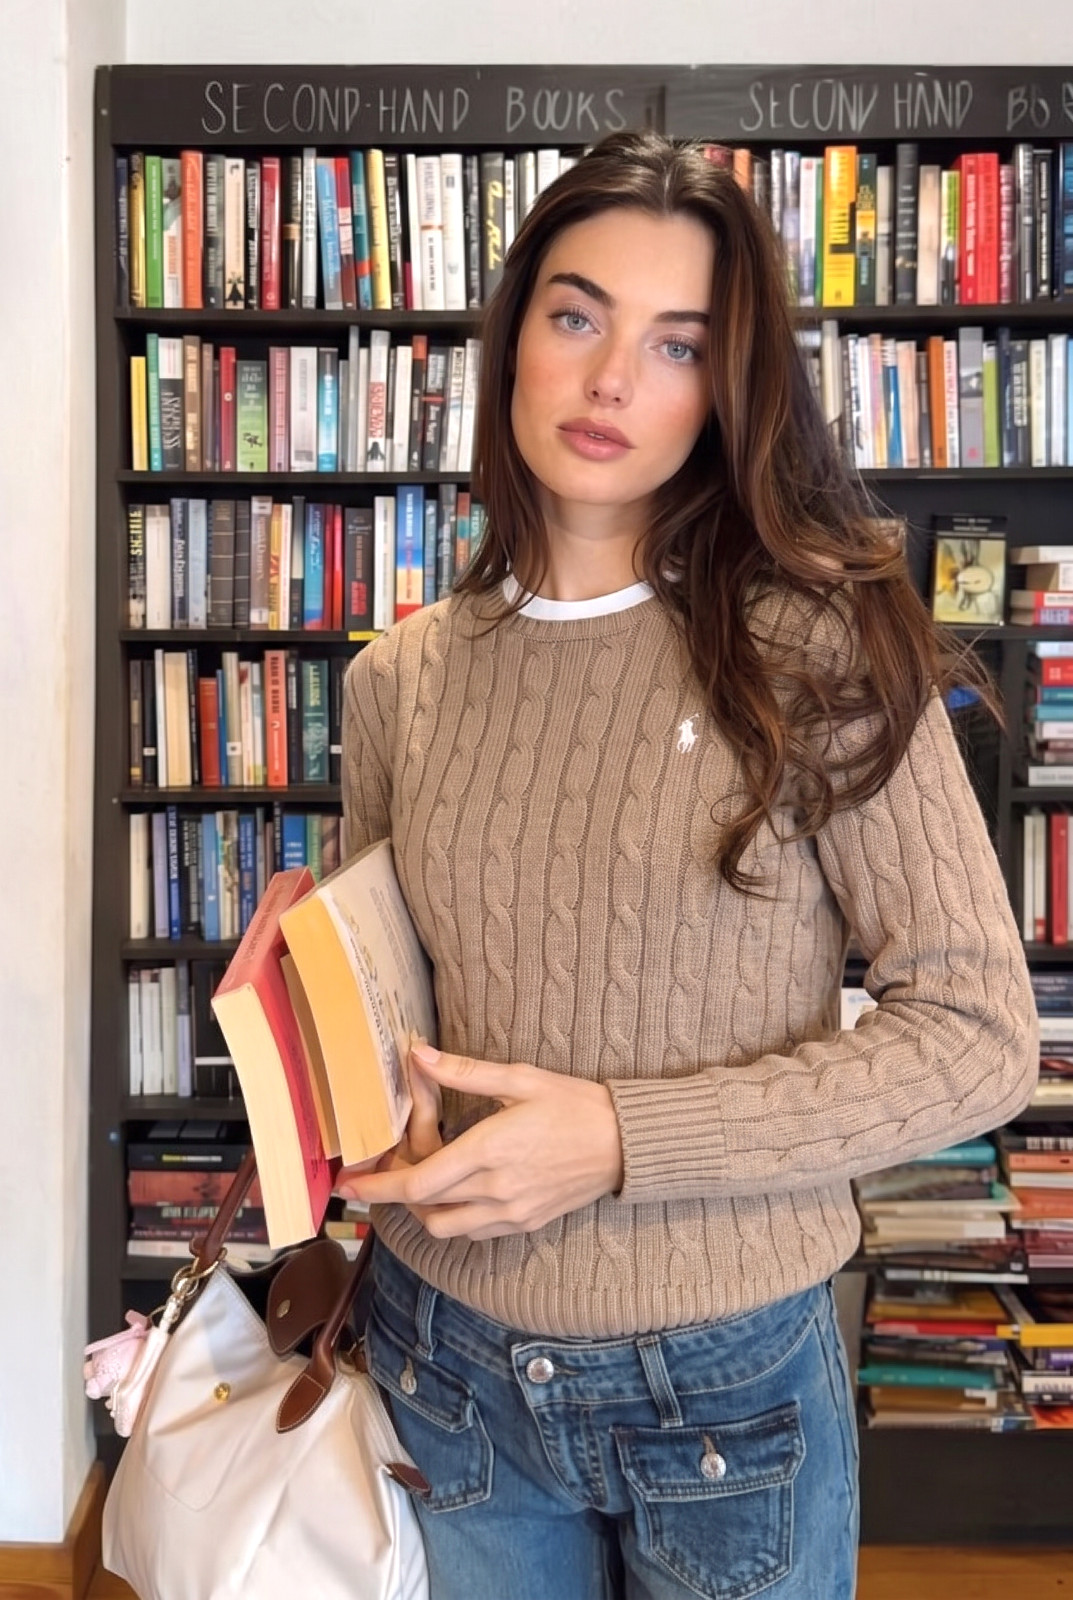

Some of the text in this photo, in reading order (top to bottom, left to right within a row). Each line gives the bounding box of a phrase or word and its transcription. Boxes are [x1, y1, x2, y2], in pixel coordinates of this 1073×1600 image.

[505, 86, 626, 132] BOOKS
[740, 79, 878, 133] SECOND
[894, 79, 973, 130] HAND
